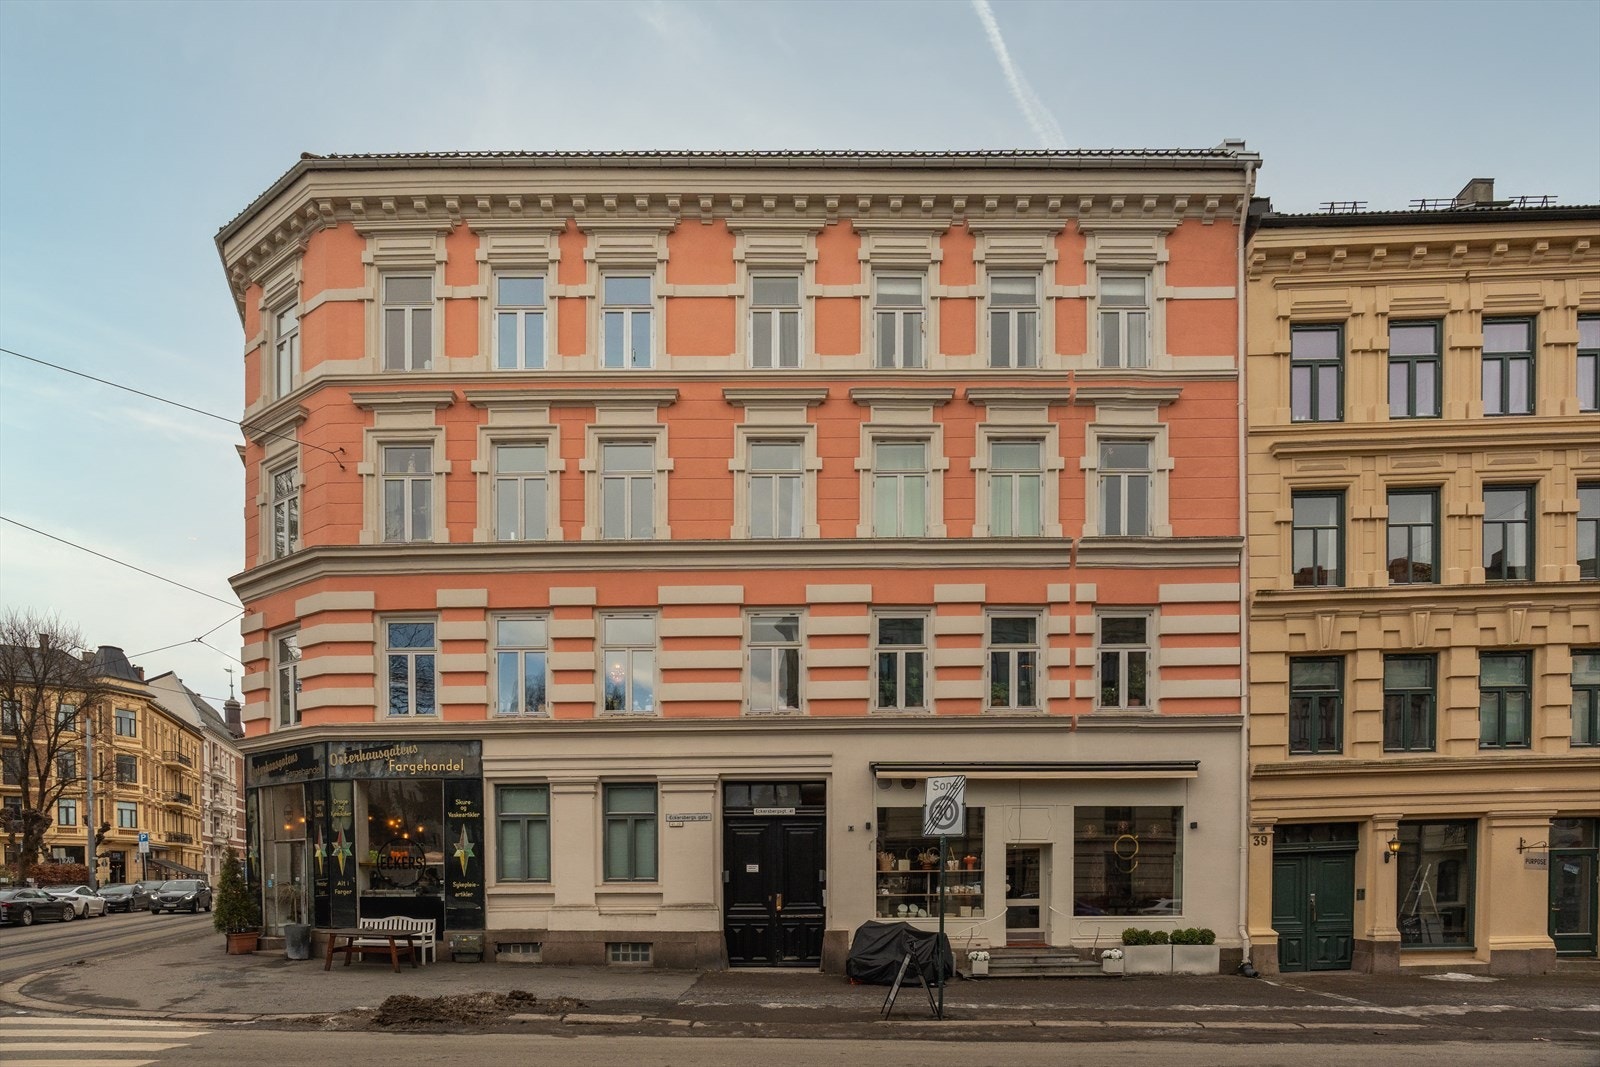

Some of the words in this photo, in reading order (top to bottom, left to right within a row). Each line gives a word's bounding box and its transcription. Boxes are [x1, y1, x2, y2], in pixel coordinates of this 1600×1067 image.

[329, 744, 418, 767] Osterhausgatens
[388, 758, 464, 774] Fargehandel
[141, 834, 147, 842] P
[1253, 835, 1268, 846] 39
[381, 856, 423, 870] ECKERS
